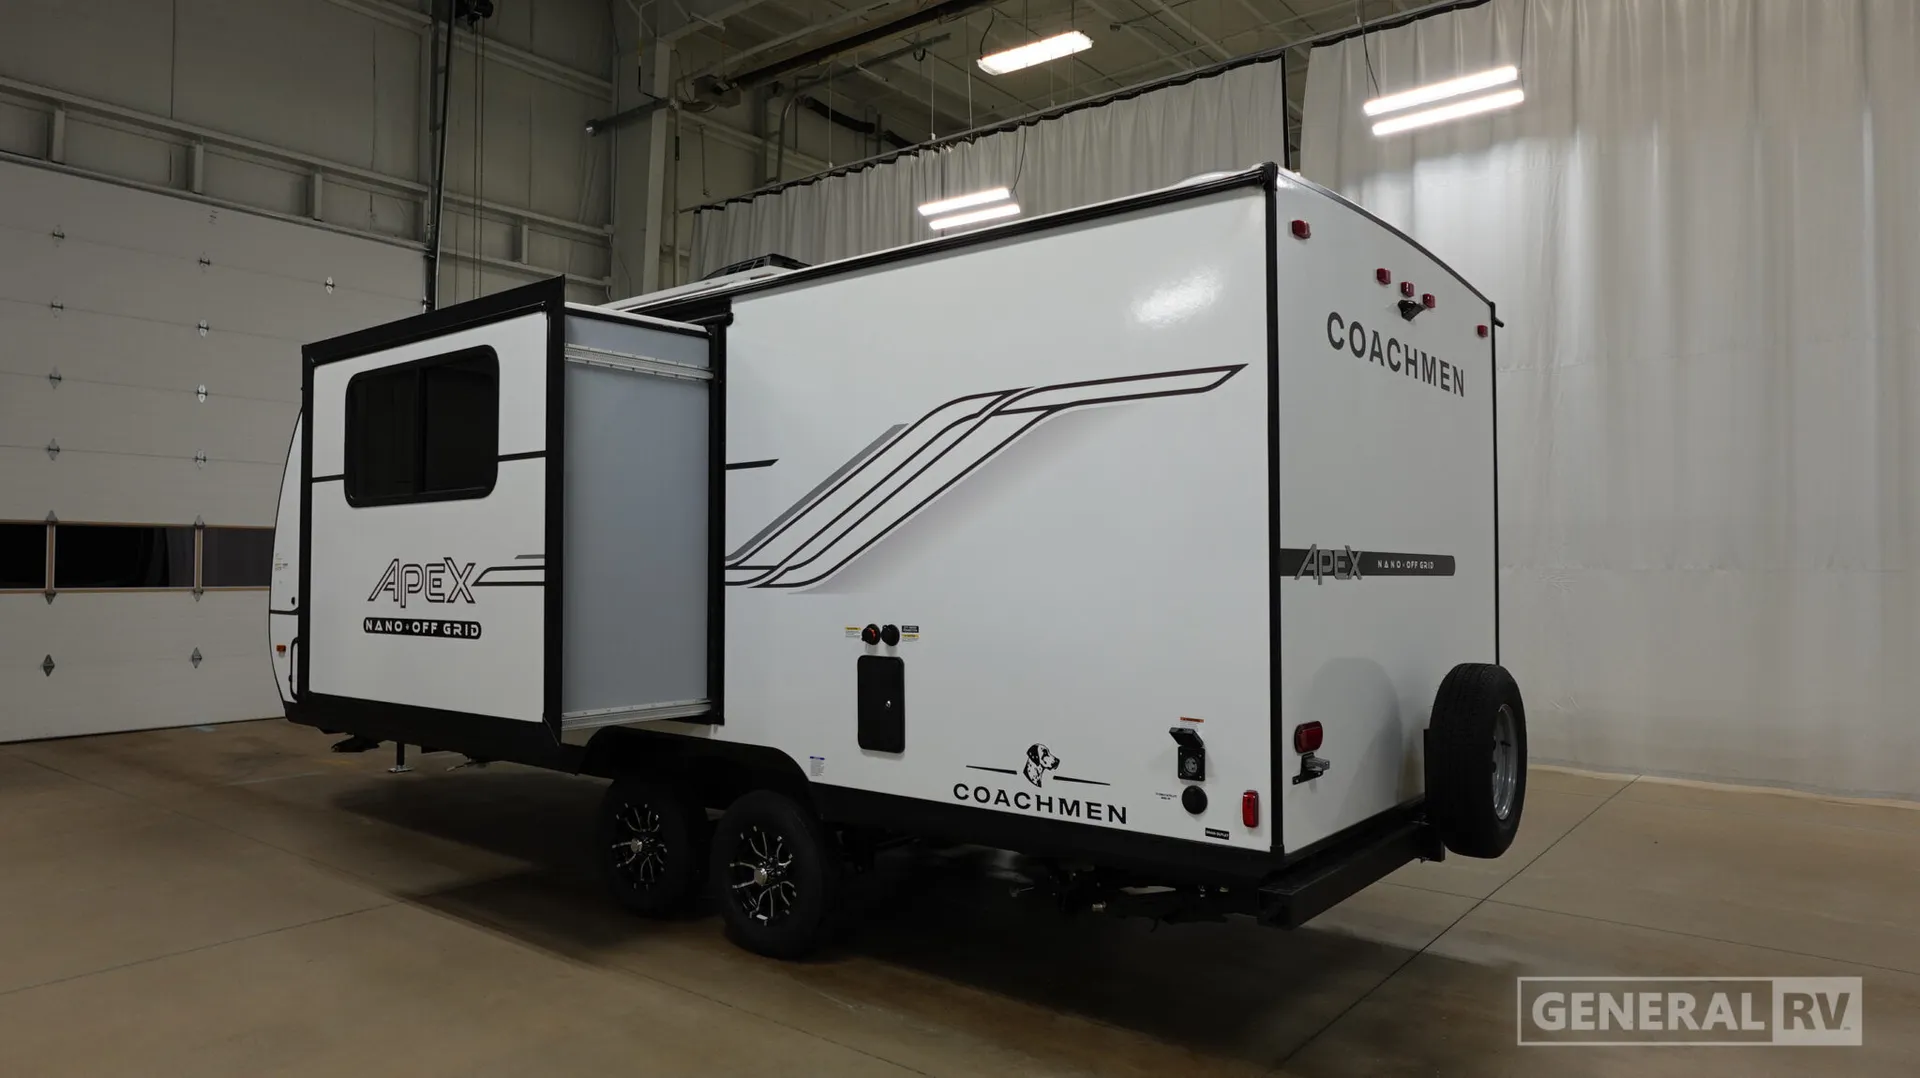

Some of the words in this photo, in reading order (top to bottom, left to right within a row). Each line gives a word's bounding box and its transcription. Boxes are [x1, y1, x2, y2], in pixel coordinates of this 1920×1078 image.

[1327, 311, 1464, 397] COACHMEN
[367, 556, 477, 609] APEX
[1294, 543, 1362, 585] APEX
[1420, 561, 1435, 570] GRID
[443, 622, 479, 637] GRID
[953, 783, 1127, 824] COACHMEN
